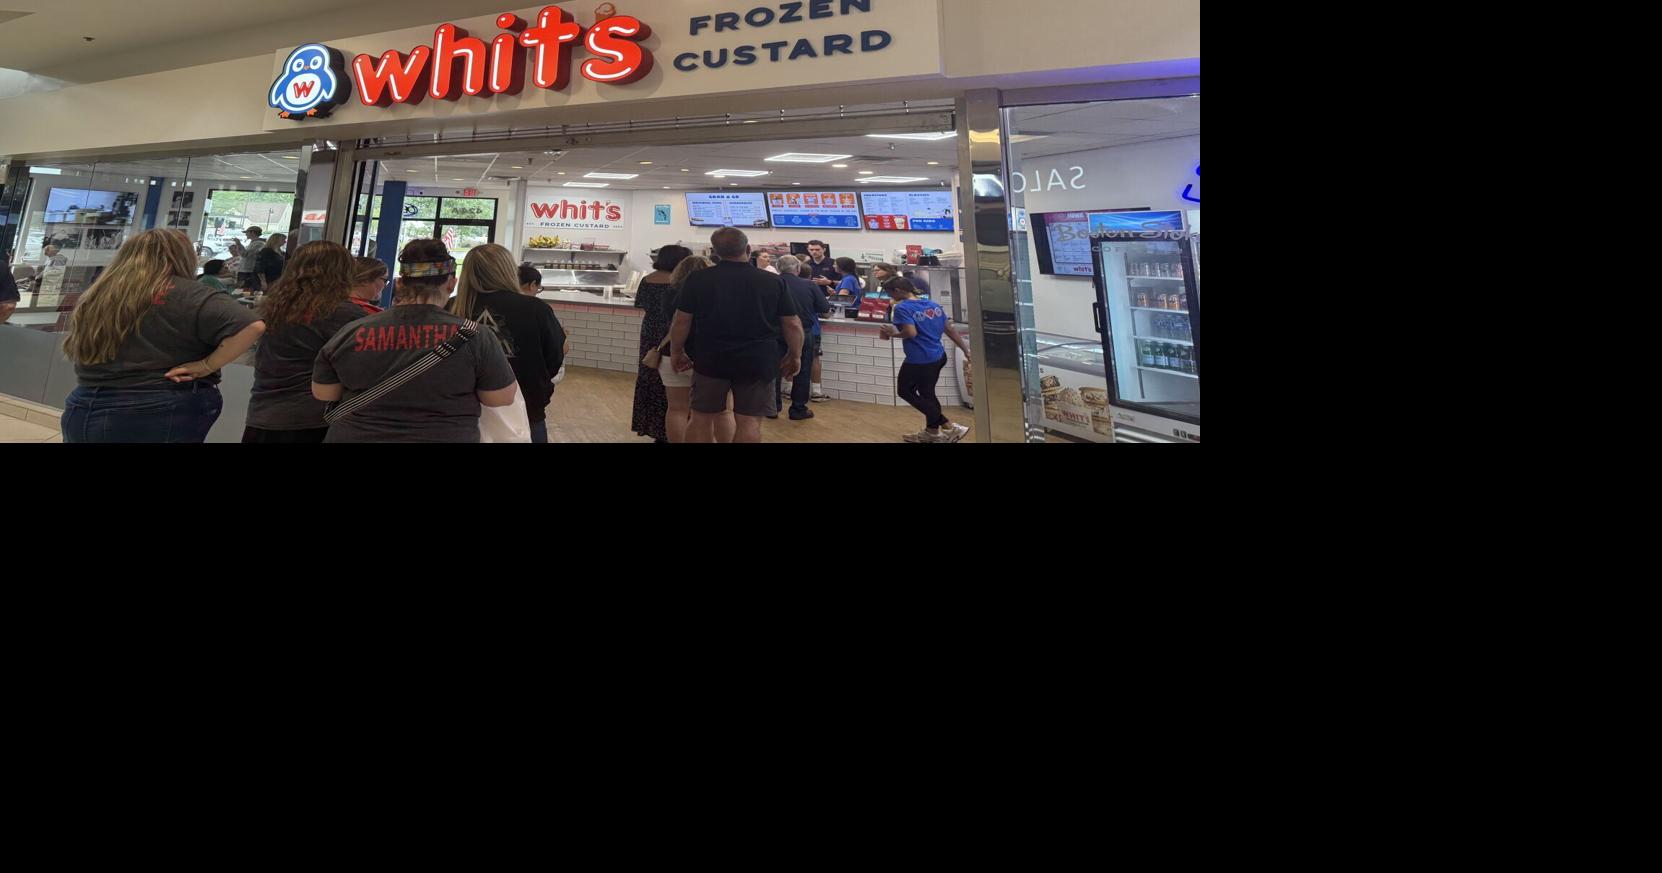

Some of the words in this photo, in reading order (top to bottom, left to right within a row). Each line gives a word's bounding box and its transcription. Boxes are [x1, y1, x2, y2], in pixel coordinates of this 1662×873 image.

[689, 0, 871, 36] FROZEN
[673, 29, 892, 72] CUSTARD
[1055, 223, 1134, 242] Boston
